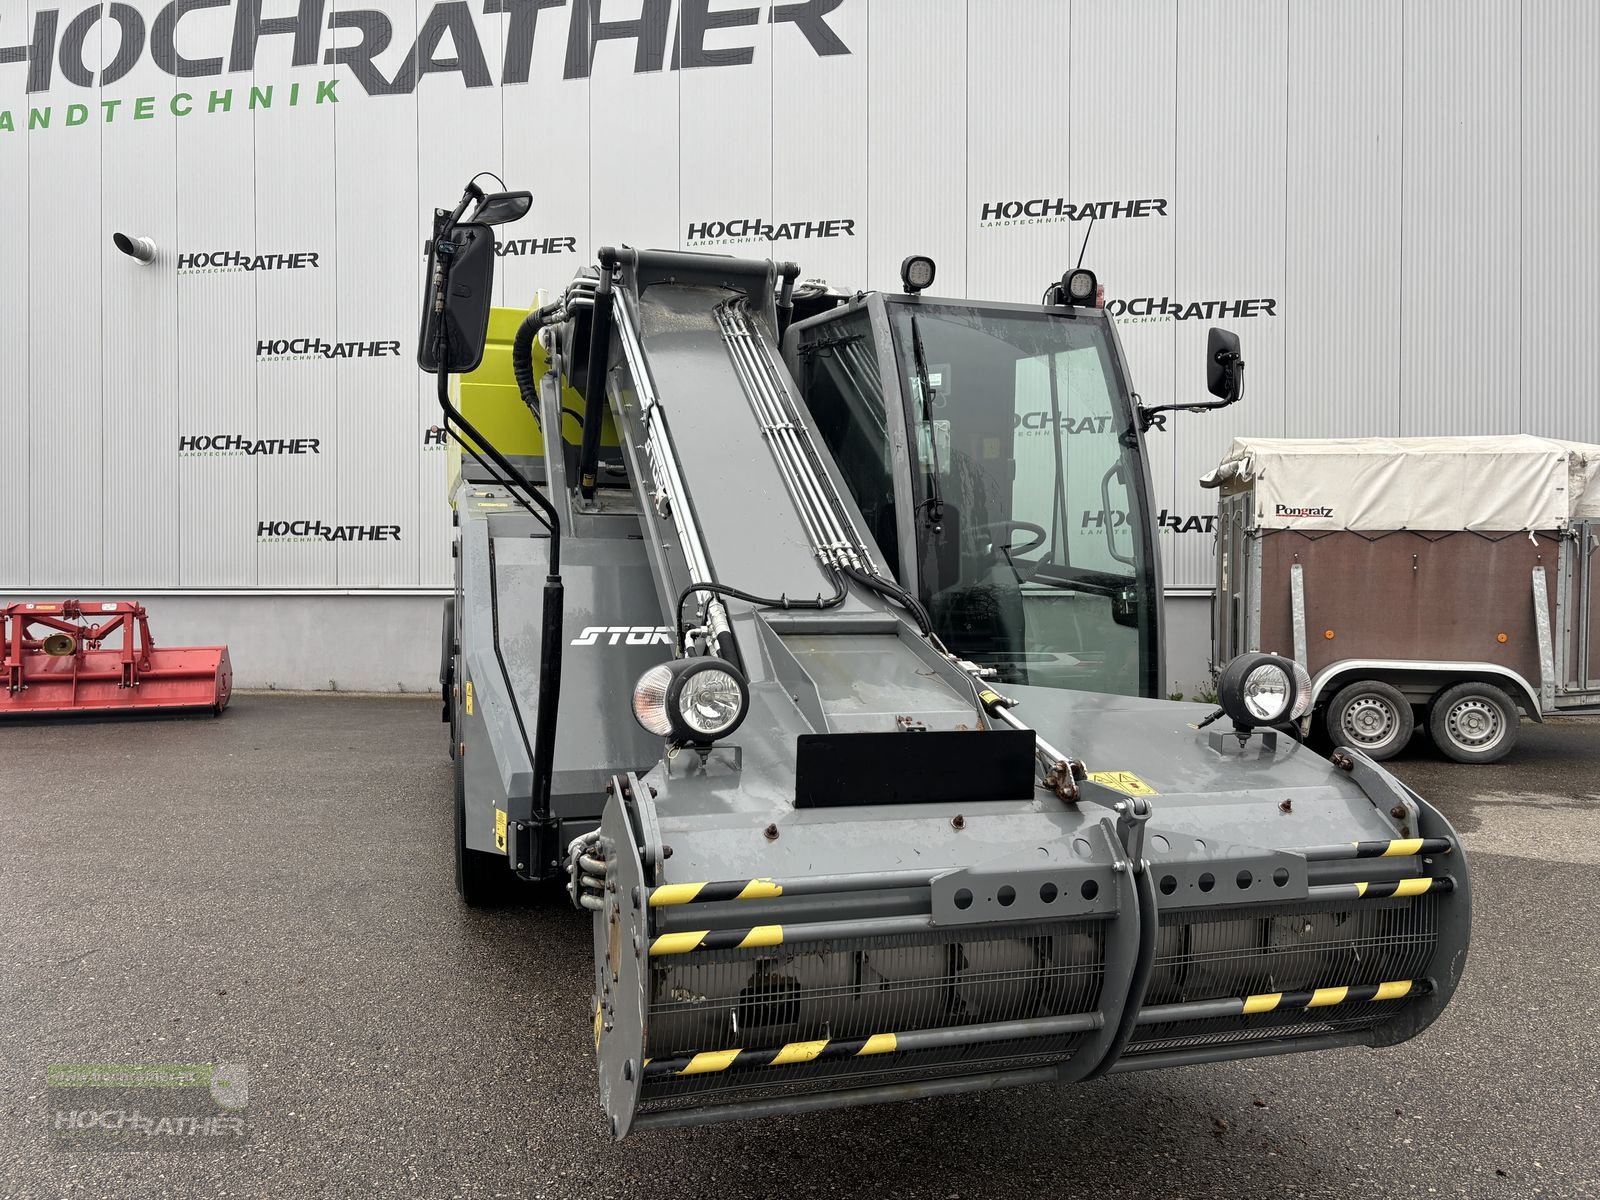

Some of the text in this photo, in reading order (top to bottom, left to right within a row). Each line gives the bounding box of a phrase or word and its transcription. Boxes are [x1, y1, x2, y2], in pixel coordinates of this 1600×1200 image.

[0, 79, 341, 132] ANDTECHNIK
[980, 197, 1168, 221] HOCHRATHER
[687, 218, 855, 241] HOCHRATHER
[980, 216, 1066, 227] LANDTECHNIK
[686, 236, 764, 247] LANDTECHNIK
[176, 267, 244, 275] LANDTECHNIK
[177, 250, 319, 271] HOCHRATHER
[1104, 296, 1277, 321] OCHRATHER
[1117, 316, 1171, 325] TECHNIK
[256, 338, 401, 359] HOCHRATHER
[256, 354, 323, 363] LANDTECHNIK
[178, 450, 245, 458] LANDTECHNIK
[179, 434, 320, 456] HOCHRATHER
[1275, 503, 1334, 518] Pongratz
[257, 519, 402, 542] HOCHRATHER
